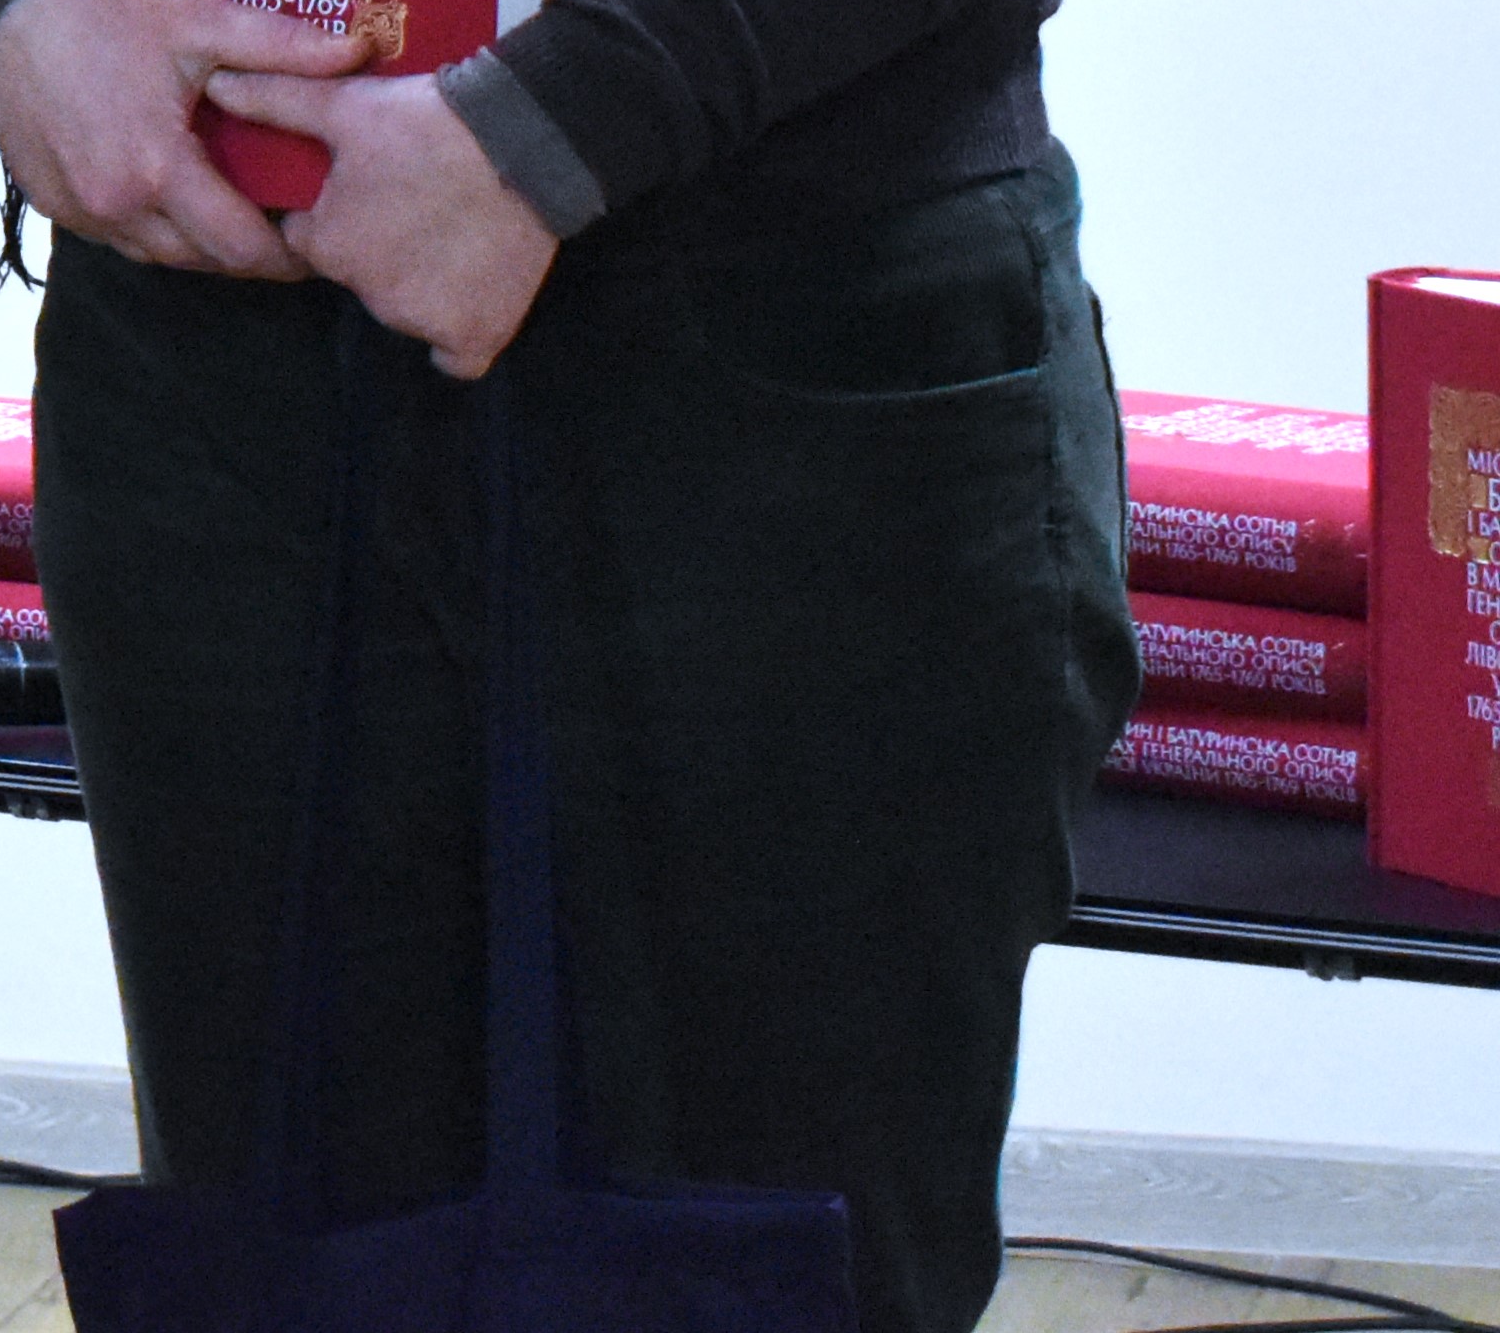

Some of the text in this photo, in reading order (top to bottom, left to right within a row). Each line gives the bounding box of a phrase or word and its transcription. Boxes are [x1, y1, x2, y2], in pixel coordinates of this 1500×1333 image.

[1126, 501, 1297, 537] ТУРИНСЬКА СОТНЯ
[1225, 532, 1295, 555] ОПИСУ
[1261, 636, 1325, 658] СОТНЯ
[1252, 653, 1325, 676] ОПИСУ
[1167, 726, 1291, 759] БАТУРИНСЬКА
[1294, 743, 1357, 768] СОТНЯ
[1285, 761, 1356, 784] ОПИСУ
